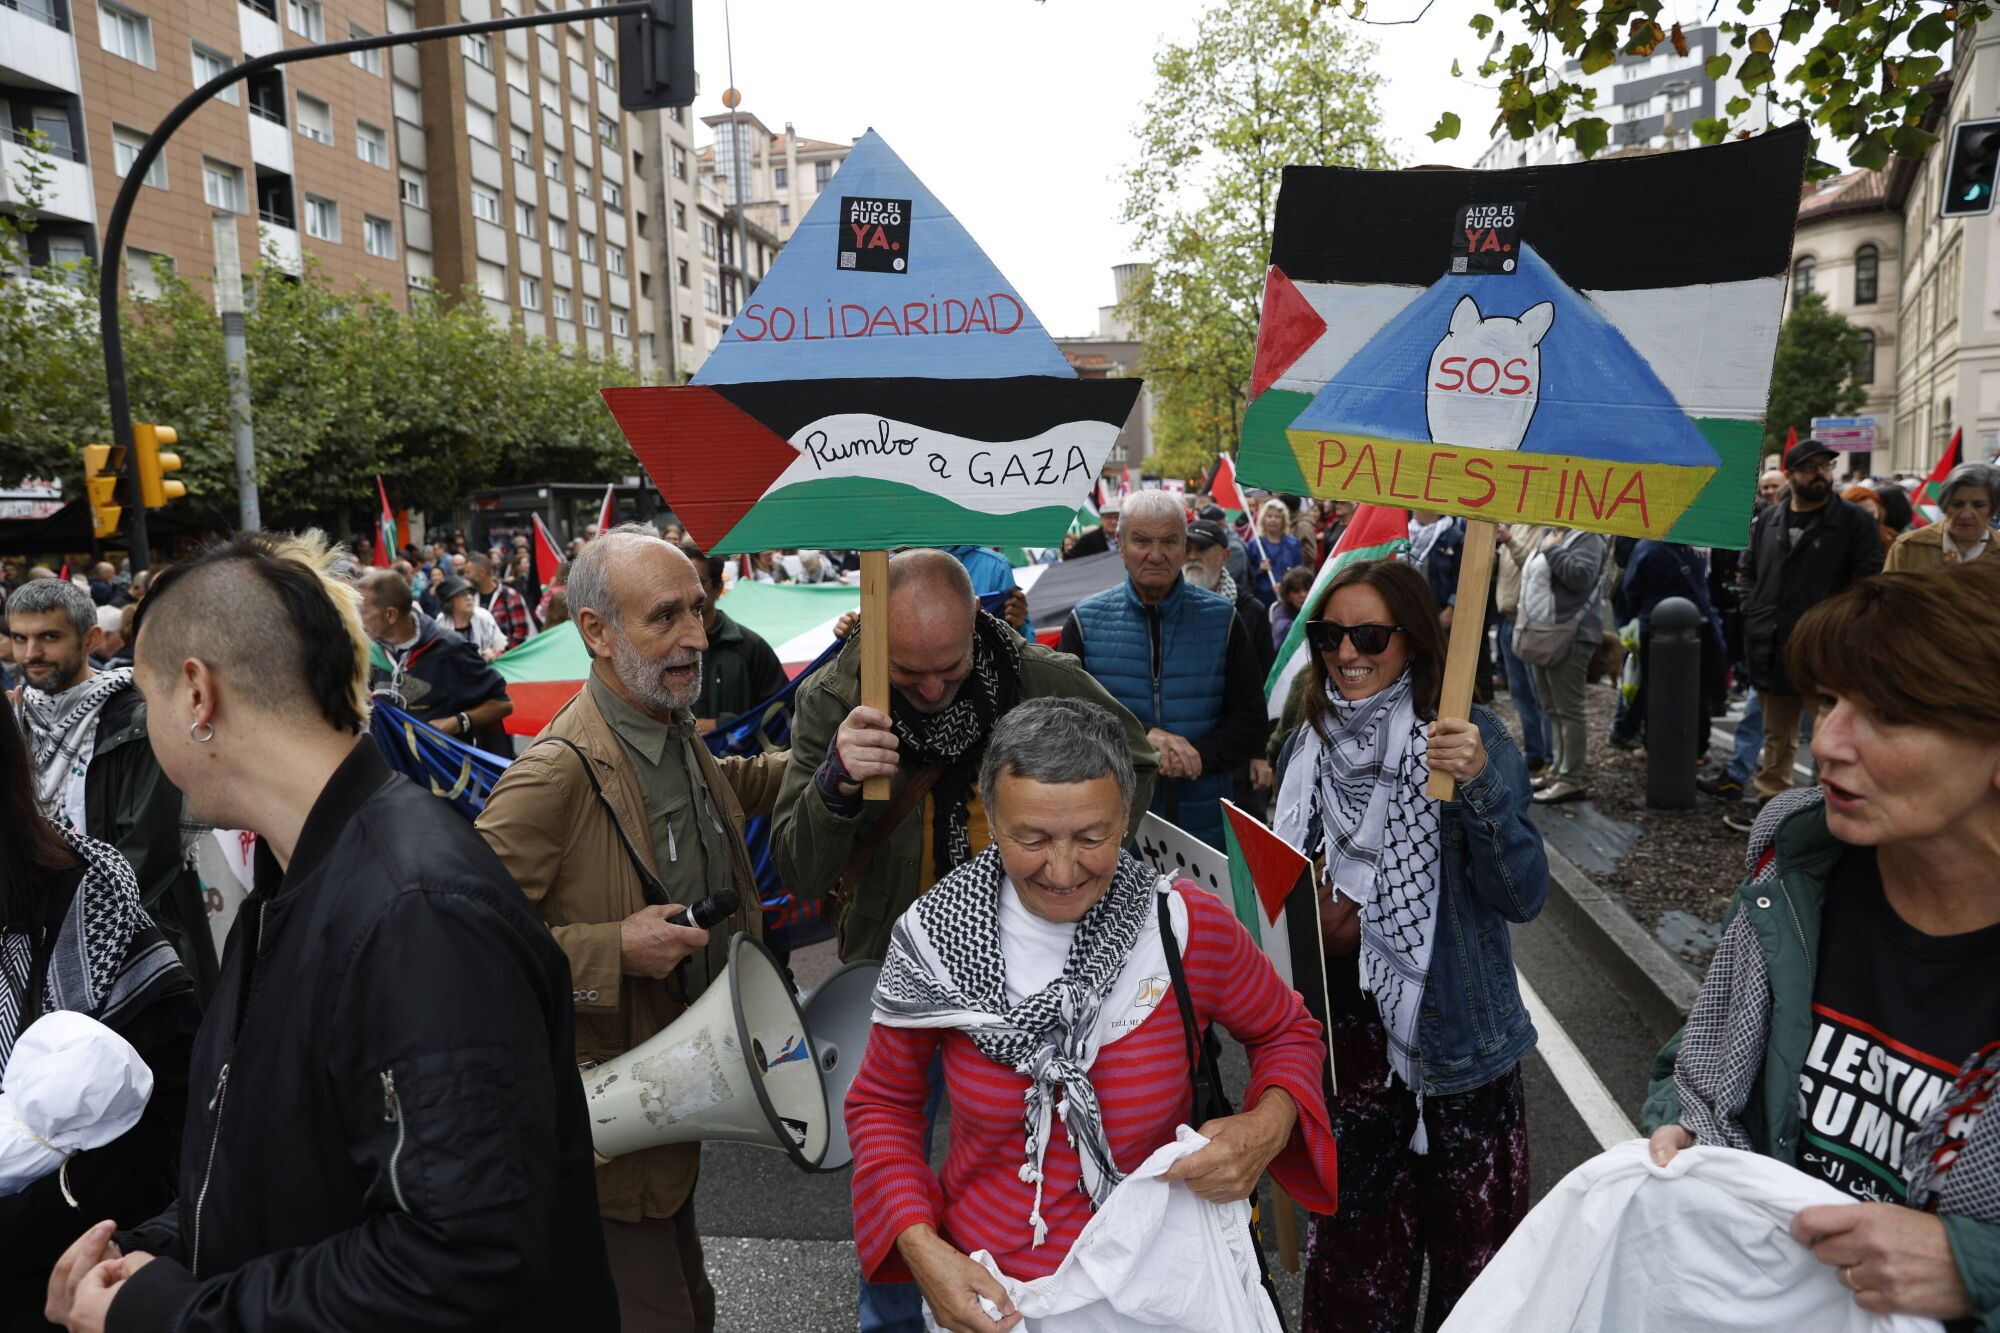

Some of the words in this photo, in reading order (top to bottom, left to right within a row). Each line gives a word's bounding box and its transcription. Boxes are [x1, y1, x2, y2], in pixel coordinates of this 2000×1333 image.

[850, 200, 883, 212] ALTO
[887, 202, 901, 213] EL
[1465, 206, 1498, 217] ALTO
[1501, 205, 1515, 216] EL
[850, 211, 901, 226] FUEGO
[1465, 215, 1515, 229] FUEGO
[850, 223, 900, 251] YA.
[1464, 227, 1512, 253] YA.
[804, 419, 919, 471] Rumbo
[928, 452, 952, 479] a
[968, 445, 1092, 488] GAZA
